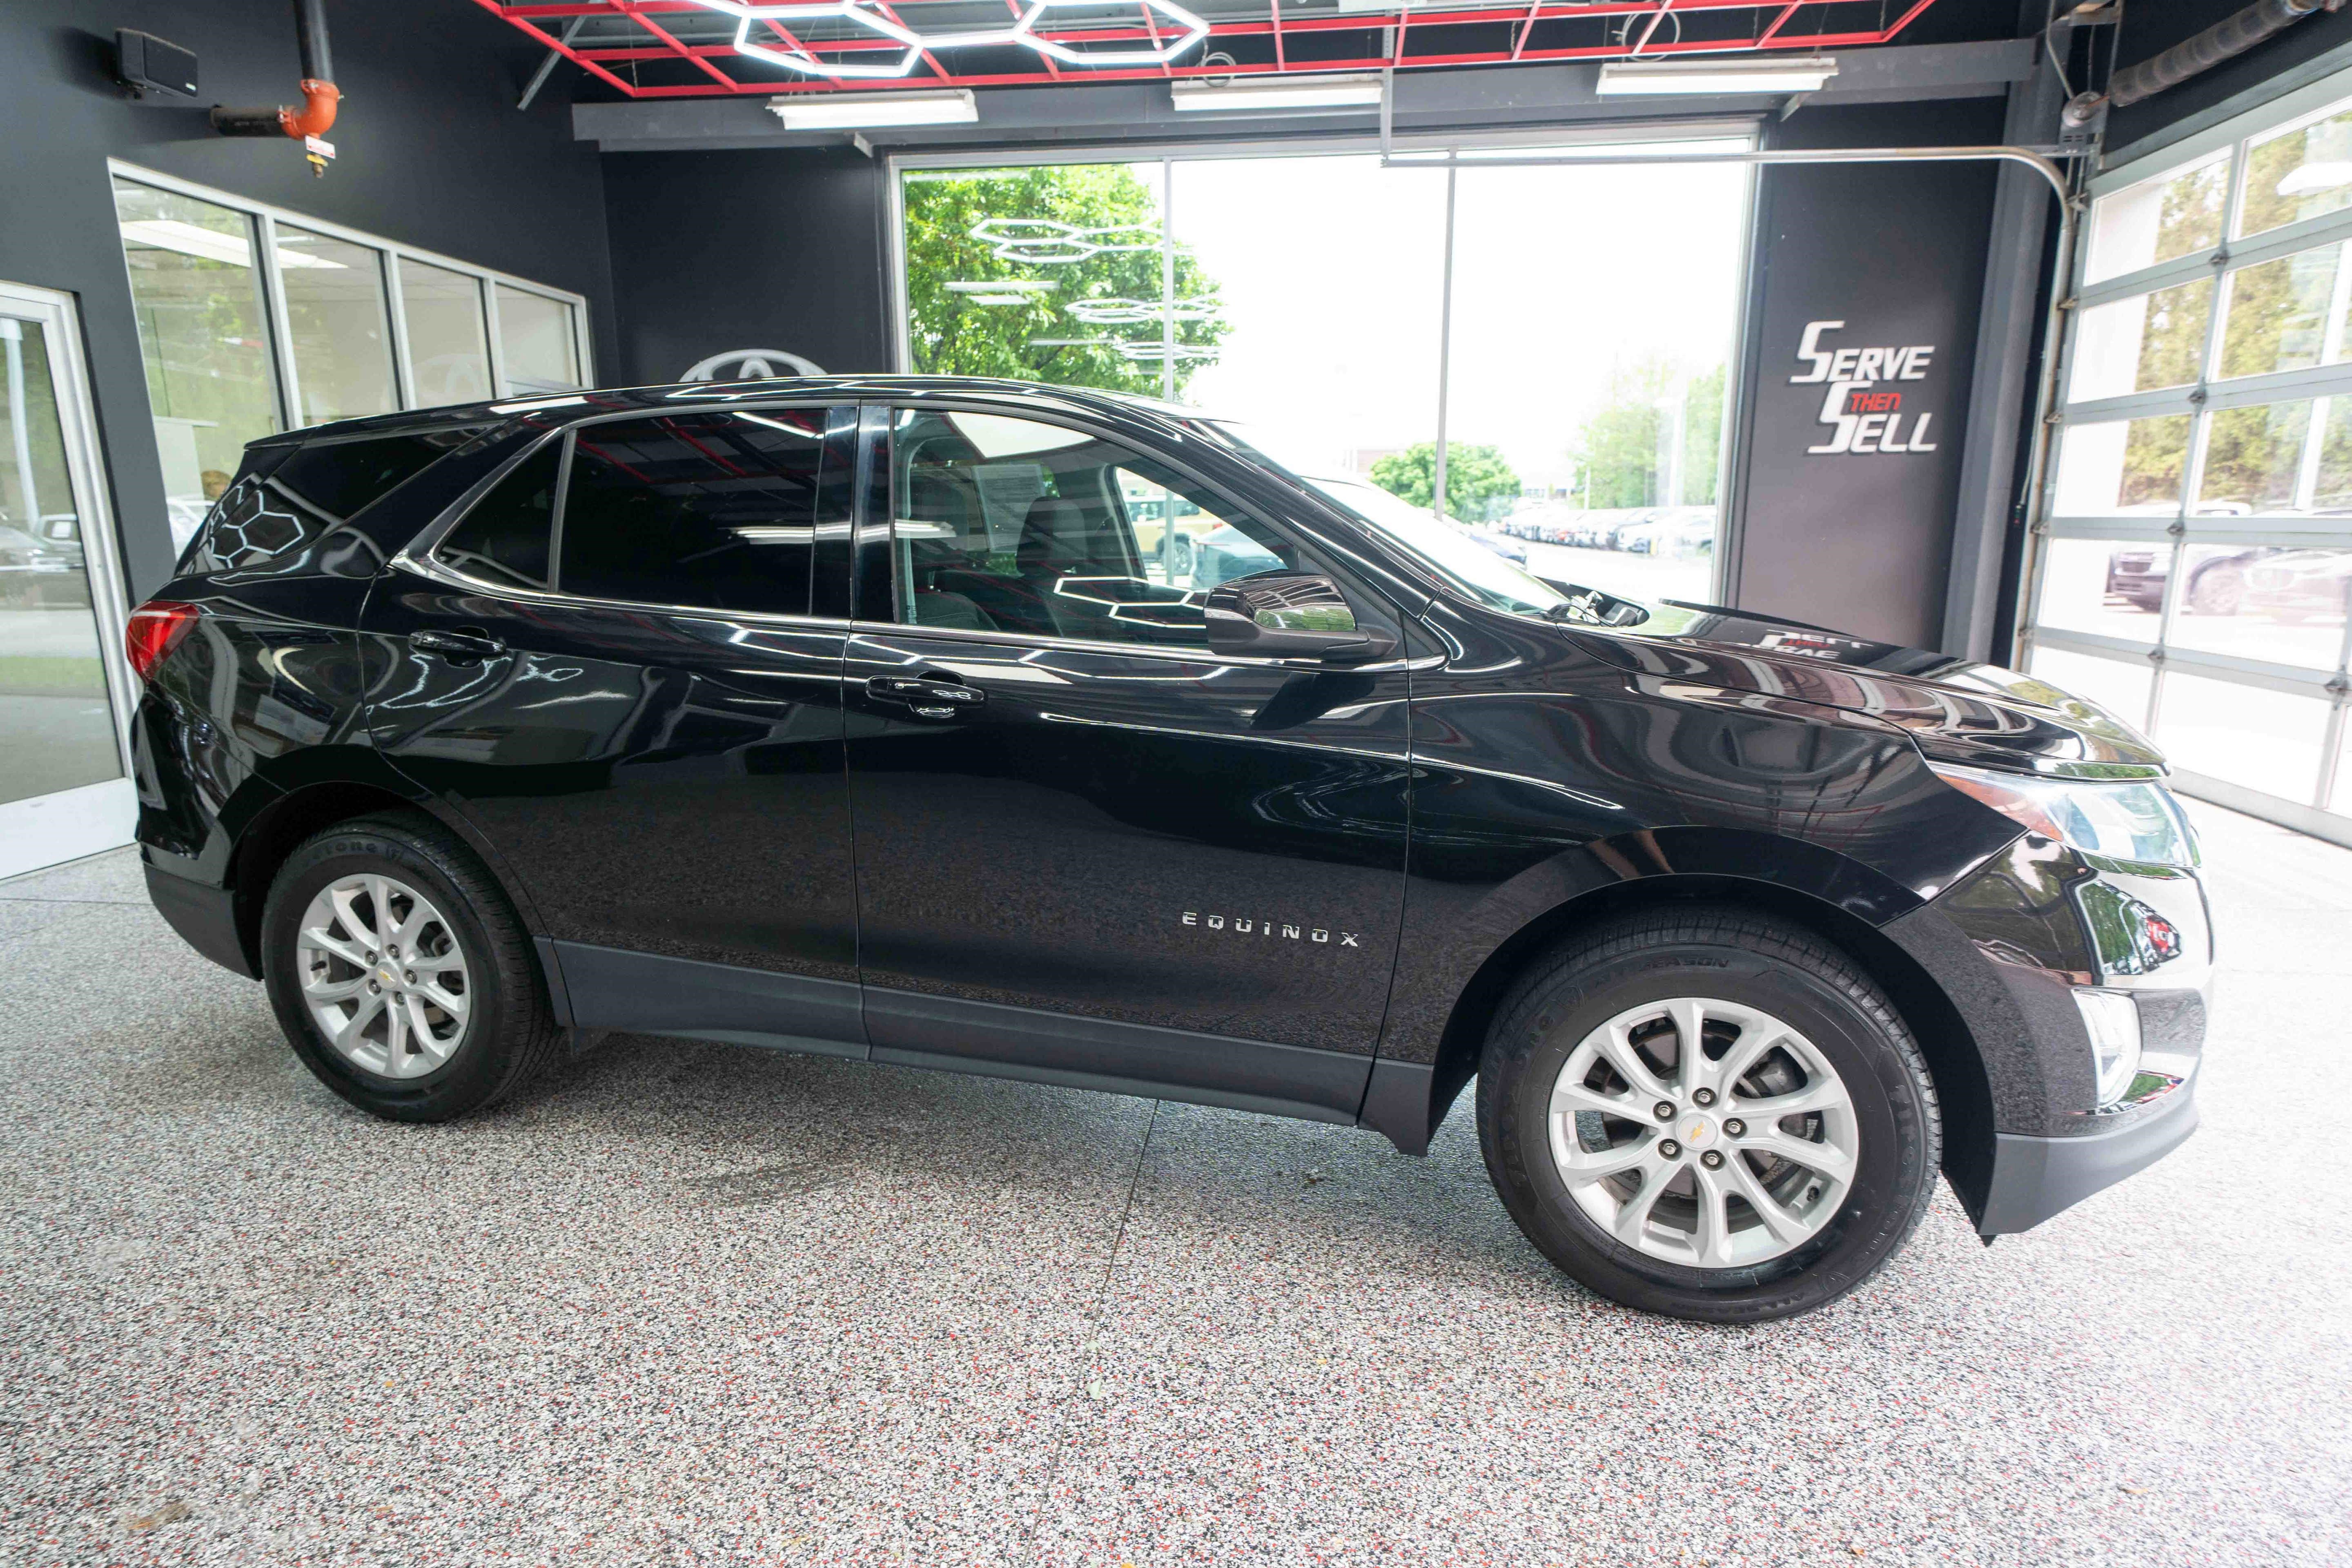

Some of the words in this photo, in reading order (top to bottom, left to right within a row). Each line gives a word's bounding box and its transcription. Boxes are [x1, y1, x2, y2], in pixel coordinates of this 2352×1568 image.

[1790, 320, 1935, 383] SERVE
[1807, 380, 1938, 454] SELL
[1182, 912, 1359, 947] EQUINOX
